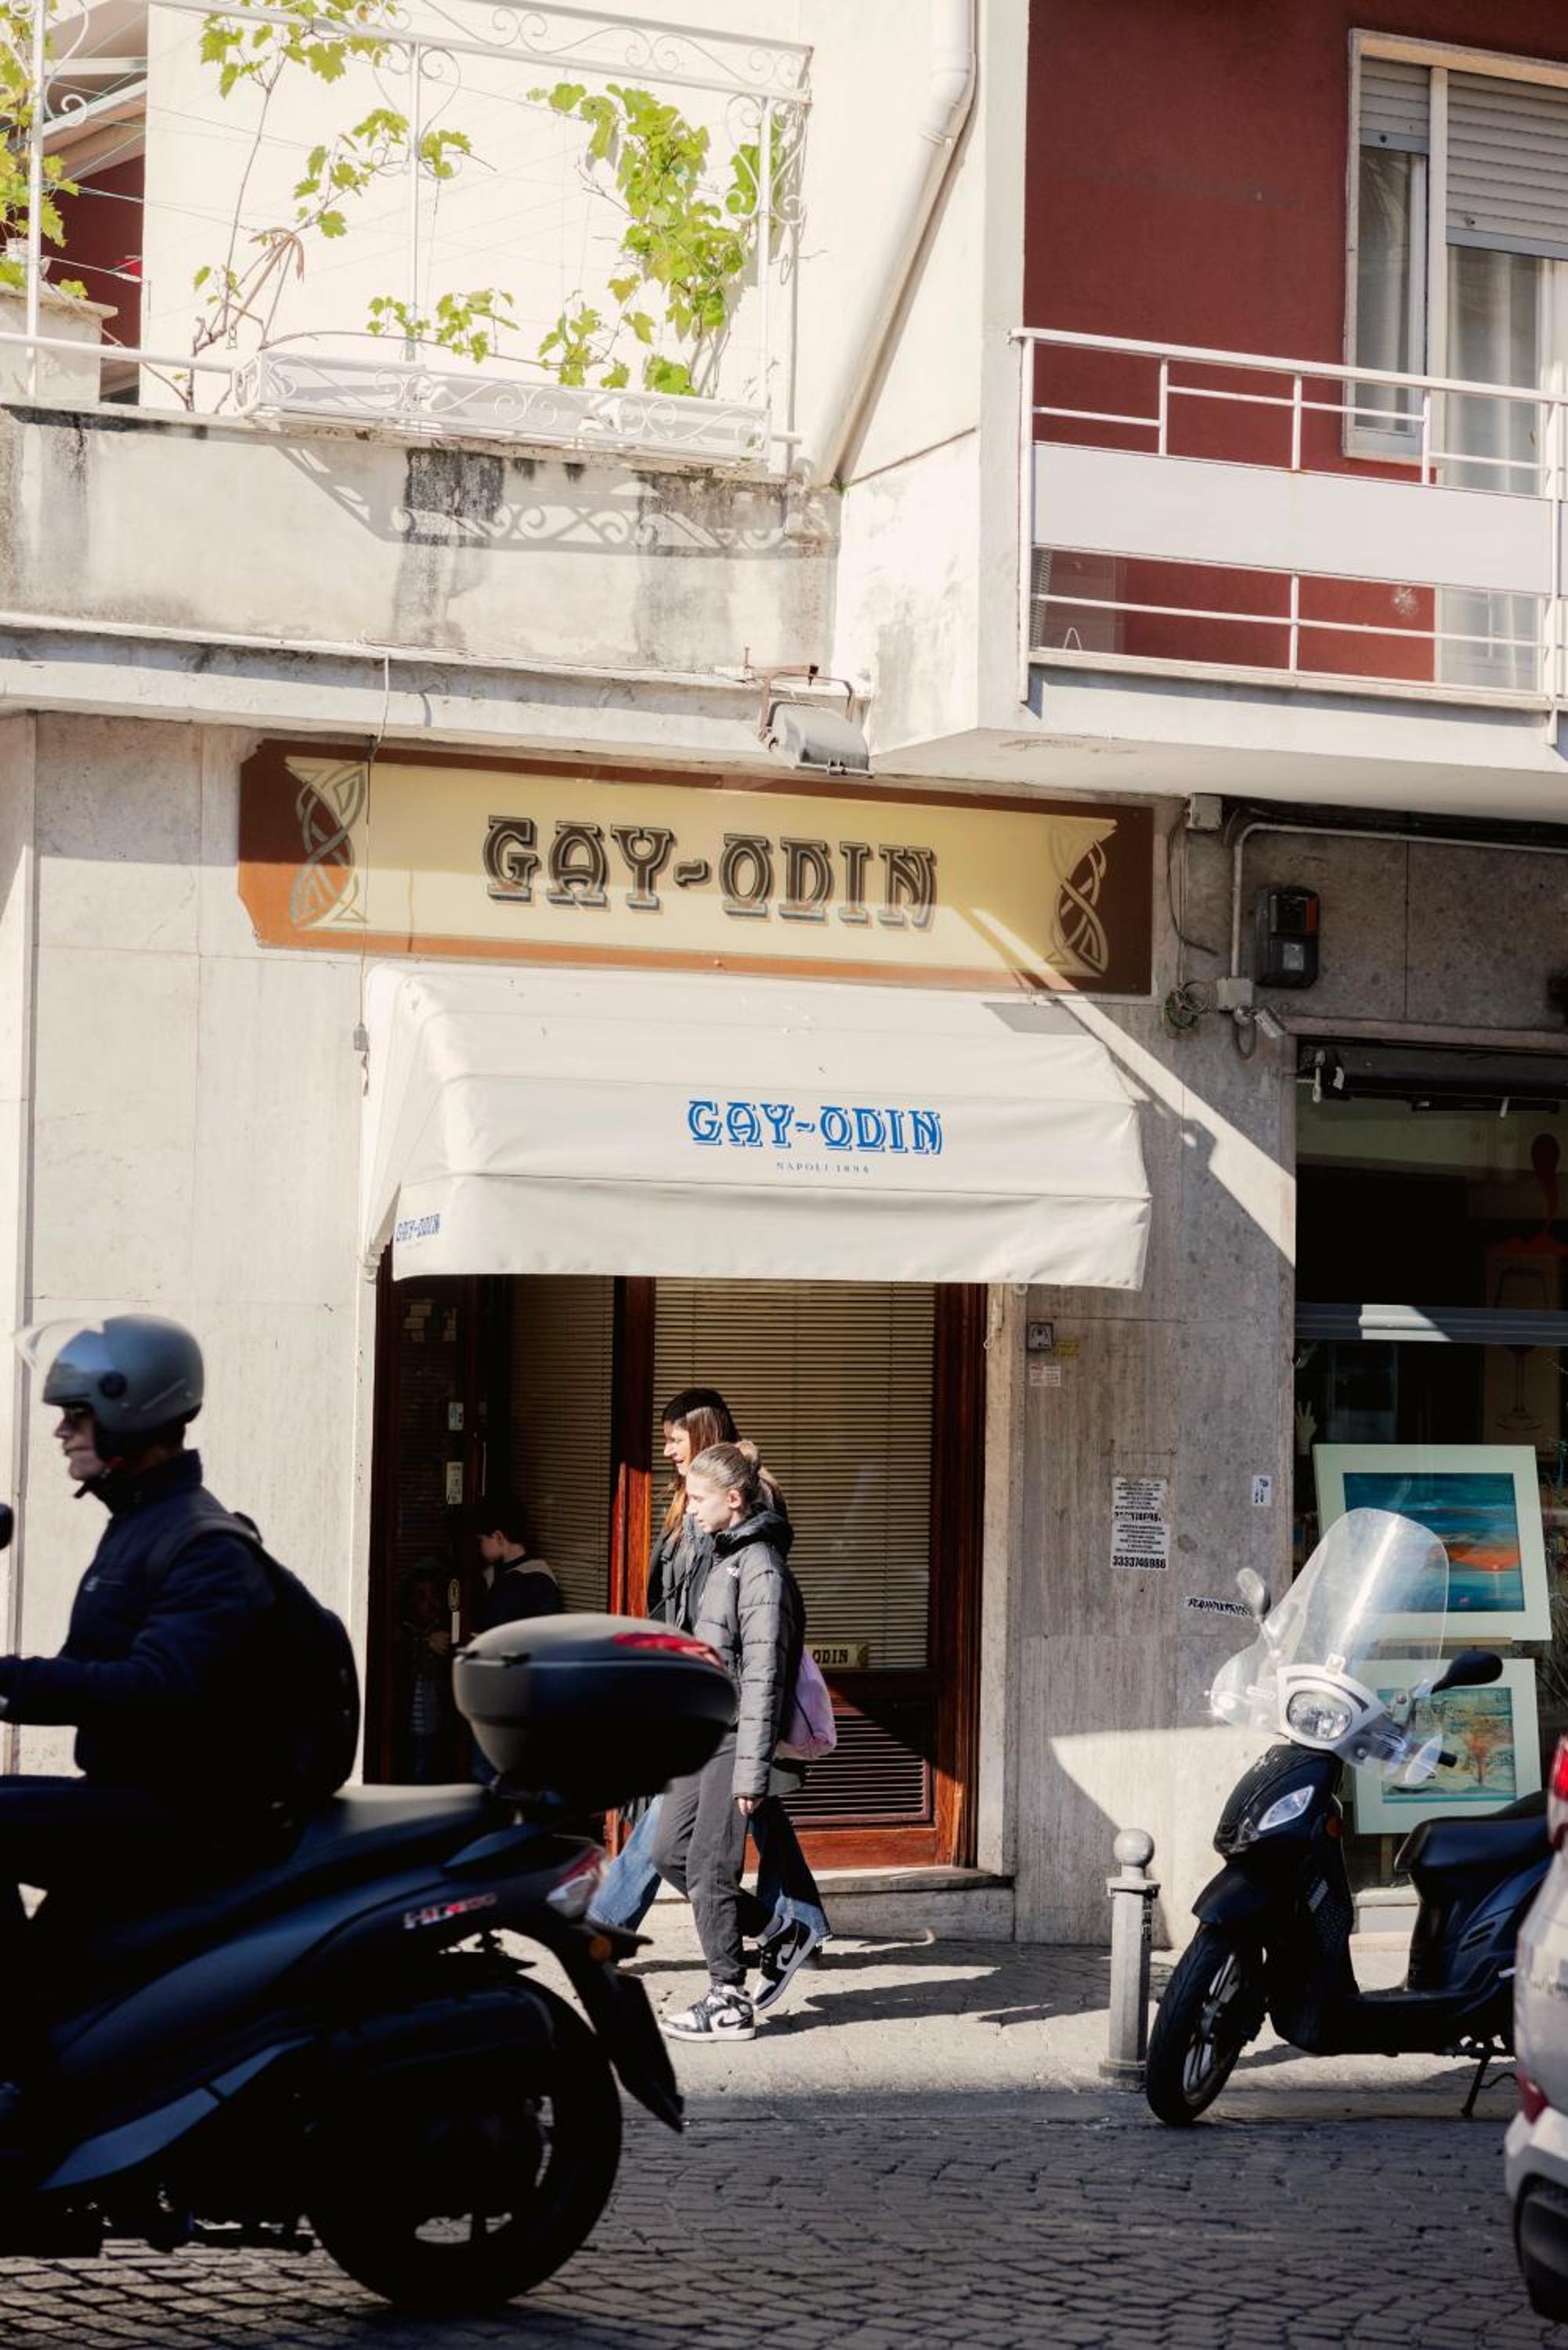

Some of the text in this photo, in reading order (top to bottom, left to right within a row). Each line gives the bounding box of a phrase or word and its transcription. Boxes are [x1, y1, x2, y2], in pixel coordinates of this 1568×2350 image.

[482, 814, 938, 931] GAY-ODIN
[688, 1101, 942, 1155] GAY-ODIN
[776, 1162, 828, 1173] NAPOLI
